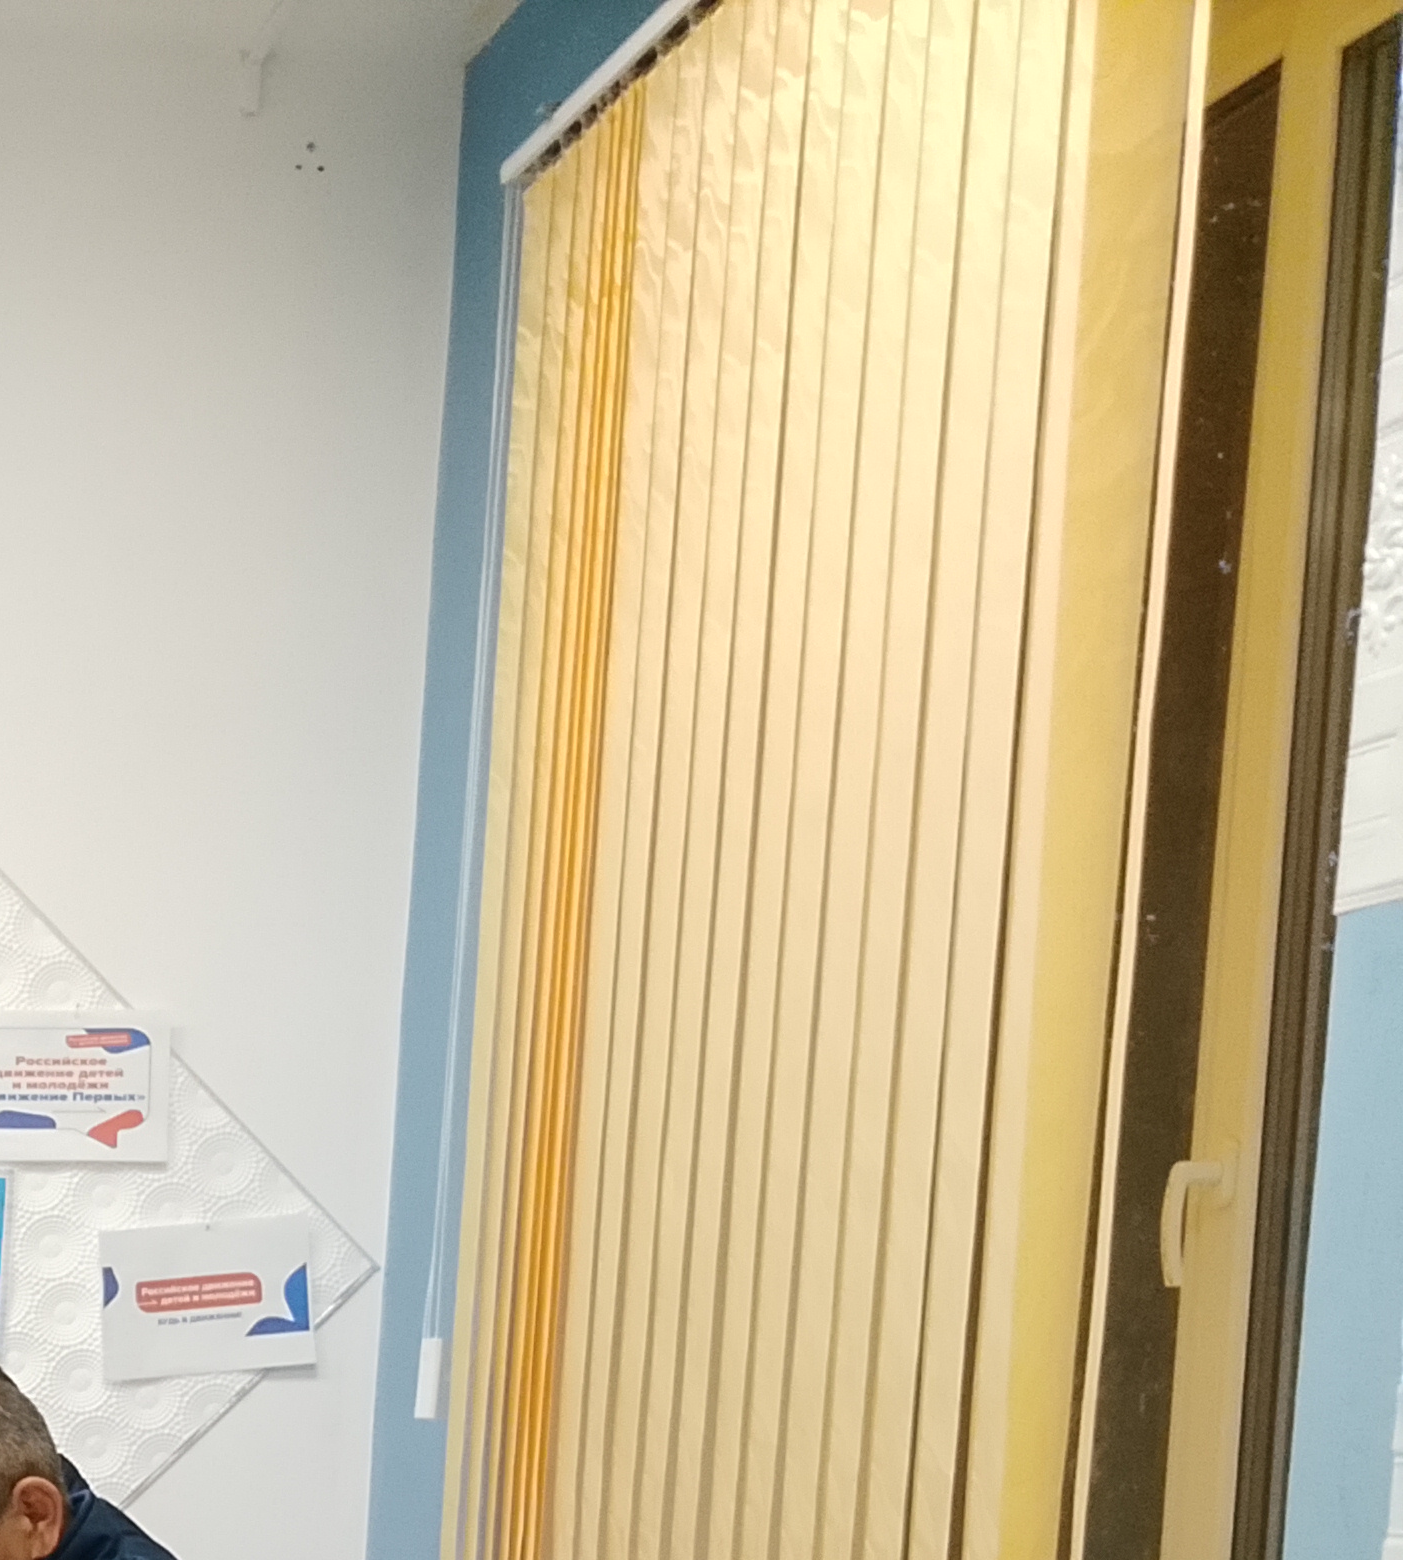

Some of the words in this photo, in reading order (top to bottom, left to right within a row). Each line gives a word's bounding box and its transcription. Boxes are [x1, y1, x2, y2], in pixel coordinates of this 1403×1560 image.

[15, 1055, 107, 1066] Российское
[78, 1068, 124, 1079] детей
[12, 1081, 21, 1090] и
[26, 1080, 109, 1091] молодёжи
[72, 1091, 146, 1104] Первых»
